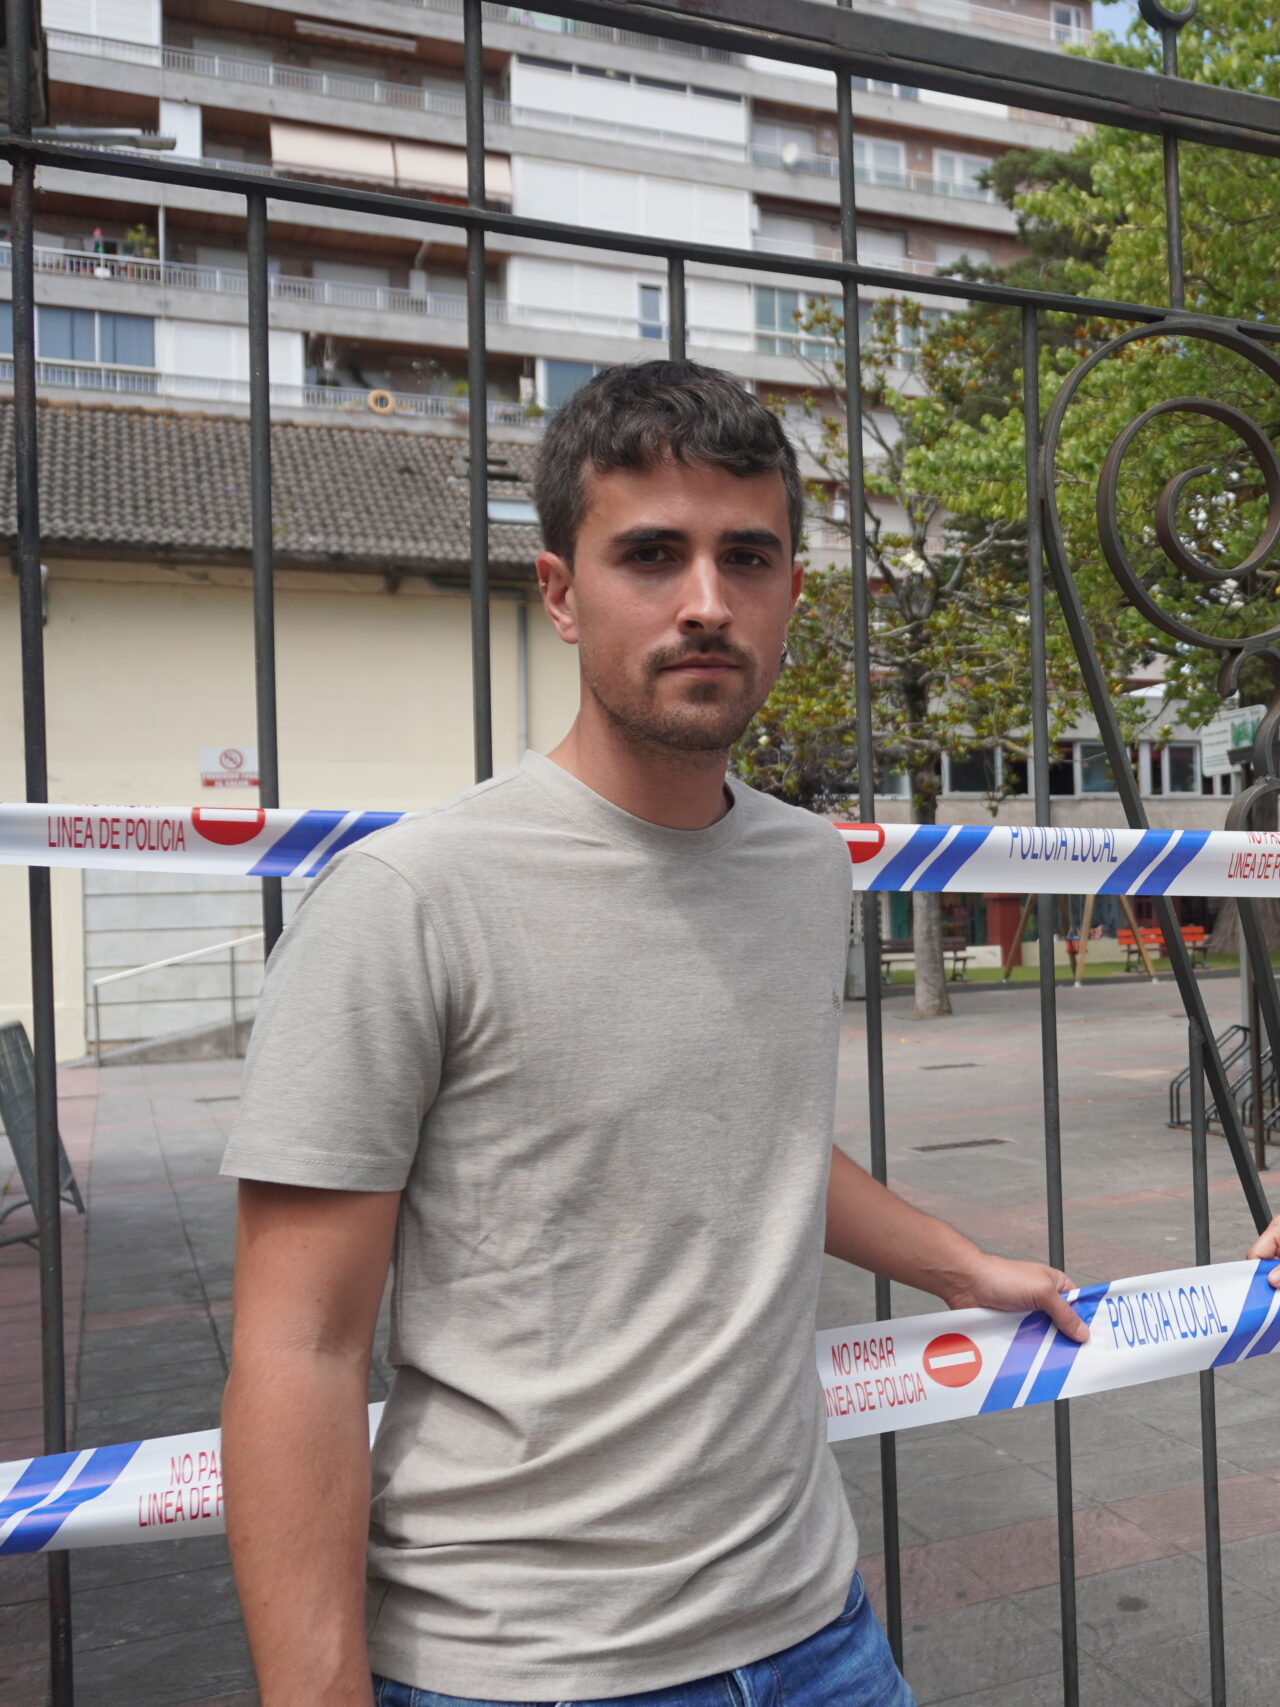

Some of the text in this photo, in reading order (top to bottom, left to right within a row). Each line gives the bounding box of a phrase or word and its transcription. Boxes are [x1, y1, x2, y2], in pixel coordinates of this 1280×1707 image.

[48, 816, 186, 852] LINEA DE POLICIA
[1228, 852, 1257, 879] LINEA
[1257, 853, 1274, 879] DE
[1106, 1285, 1228, 1349] POLICIA LOCAL
[831, 1336, 896, 1377] NO PASAR
[824, 1372, 928, 1418] INEA DE POLICIA
[170, 1453, 194, 1486] NO
[139, 1489, 186, 1527] LINEA
[189, 1485, 212, 1521] DE
